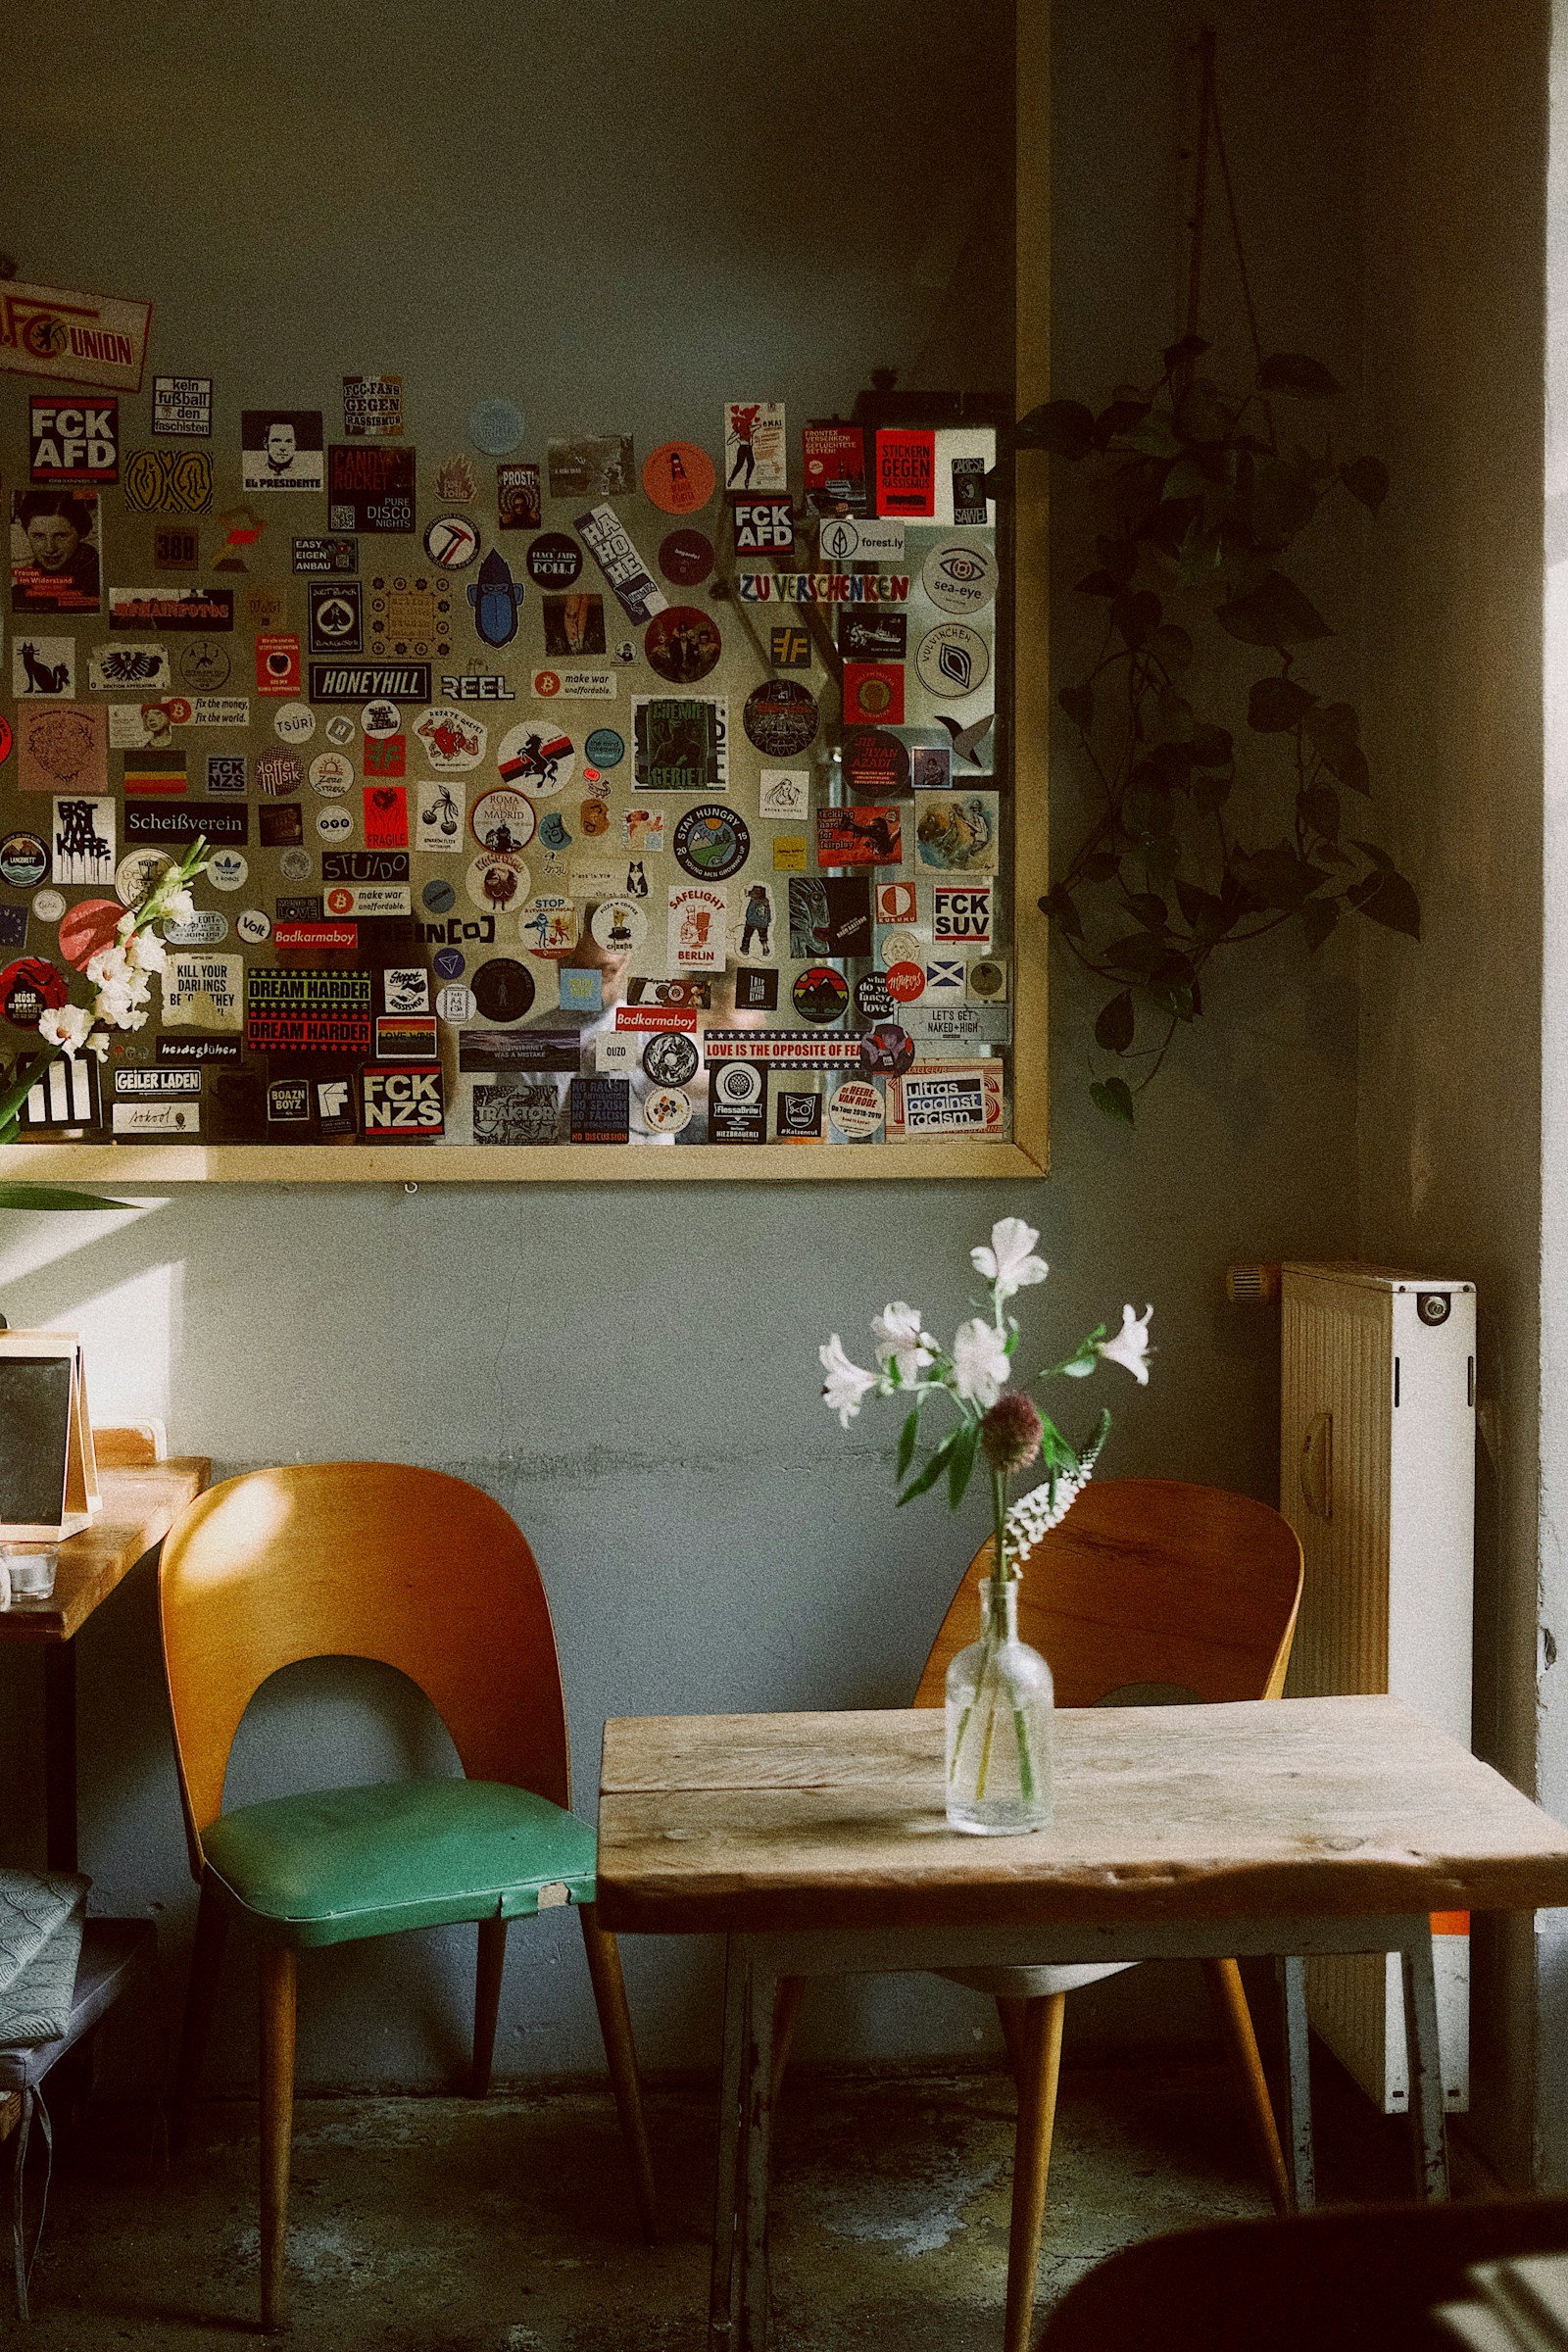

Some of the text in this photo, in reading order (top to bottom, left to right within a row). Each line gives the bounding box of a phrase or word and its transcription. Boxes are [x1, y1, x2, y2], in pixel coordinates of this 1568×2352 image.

[70, 326, 133, 366] UNION
[173, 380, 199, 392] kein
[159, 393, 207, 407] fußball
[346, 398, 400, 412] GEGEN
[177, 407, 201, 419] den
[32, 409, 115, 439] FCK
[155, 420, 208, 434] faschisten
[347, 416, 401, 426] RASSISMUS
[32, 439, 117, 468] AFD
[882, 445, 930, 460] STICKERN
[882, 460, 931, 478] GEGEN
[246, 478, 321, 488] EL PRESIDENTE
[503, 470, 535, 486] PROST!
[882, 478, 930, 489] RASSISMUS
[367, 507, 411, 519] DISCO
[736, 506, 792, 526] FCK
[737, 526, 793, 548] AFD
[861, 537, 904, 553] forest.ly
[534, 563, 576, 574] DOLLS
[742, 574, 909, 602] ZU VERSCHENKEN
[934, 580, 982, 599] sea-eye
[922, 626, 971, 662] VULVINCHEN
[321, 670, 419, 694] HONEYHILL
[442, 675, 515, 700] REEL
[196, 698, 248, 712] fix the money,
[196, 714, 247, 727] fix the world.
[209, 761, 245, 774] FCK
[209, 775, 245, 788] NZS
[490, 795, 519, 805] ROMA
[485, 811, 524, 820] MADRID
[818, 811, 854, 820] tackling
[128, 813, 243, 833] Scheißverein
[678, 808, 741, 841] STAY HUNGRY
[368, 833, 406, 847] FRAGILE
[737, 832, 748, 841] 15
[819, 831, 833, 840] for
[676, 847, 687, 856] 20
[819, 841, 854, 851] fairplay
[685, 858, 704, 875] YOUNG
[718, 856, 743, 876] GROWING
[739, 846, 747, 856] UP
[359, 893, 403, 902] make war
[535, 899, 564, 908] STOP
[668, 890, 725, 910] SAFELIGHT
[936, 894, 989, 914] FCK
[278, 909, 318, 921] LOVE
[600, 902, 639, 914] PIZZA COFFEE
[243, 917, 266, 937] Volt
[936, 916, 989, 935] SUV
[275, 931, 356, 947] Badkarmaboy
[678, 951, 714, 961] BERLIN
[177, 965, 227, 978] KILL YOUR
[249, 981, 369, 999] DREAM HARDER
[859, 983, 873, 992] do
[212, 994, 234, 1006] THEY
[389, 997, 424, 1011] RASSISMUS
[618, 1013, 697, 1029] Badkarmaboy
[932, 1010, 973, 1021] LET'S GET
[249, 1022, 369, 1041] DREAM HARDER
[379, 1032, 435, 1041] LOVE WINS
[162, 1042, 237, 1058] heideglühen
[607, 1047, 626, 1059] OUZO
[707, 1044, 844, 1057] LOVE IS THE OPPOSITE OF
[162, 1072, 199, 1089] LADEN
[364, 1074, 440, 1102] FCK
[906, 1081, 959, 1096] ultras
[275, 1100, 302, 1110] BOYZ
[590, 1100, 627, 1110] SEXISM
[838, 1094, 878, 1108] VAN RODE
[909, 1095, 980, 1111] against
[365, 1100, 443, 1127] NZS
[476, 1105, 557, 1123] TRAKTOR
[840, 1105, 853, 1114] Tour
[910, 1111, 975, 1127] racism.
